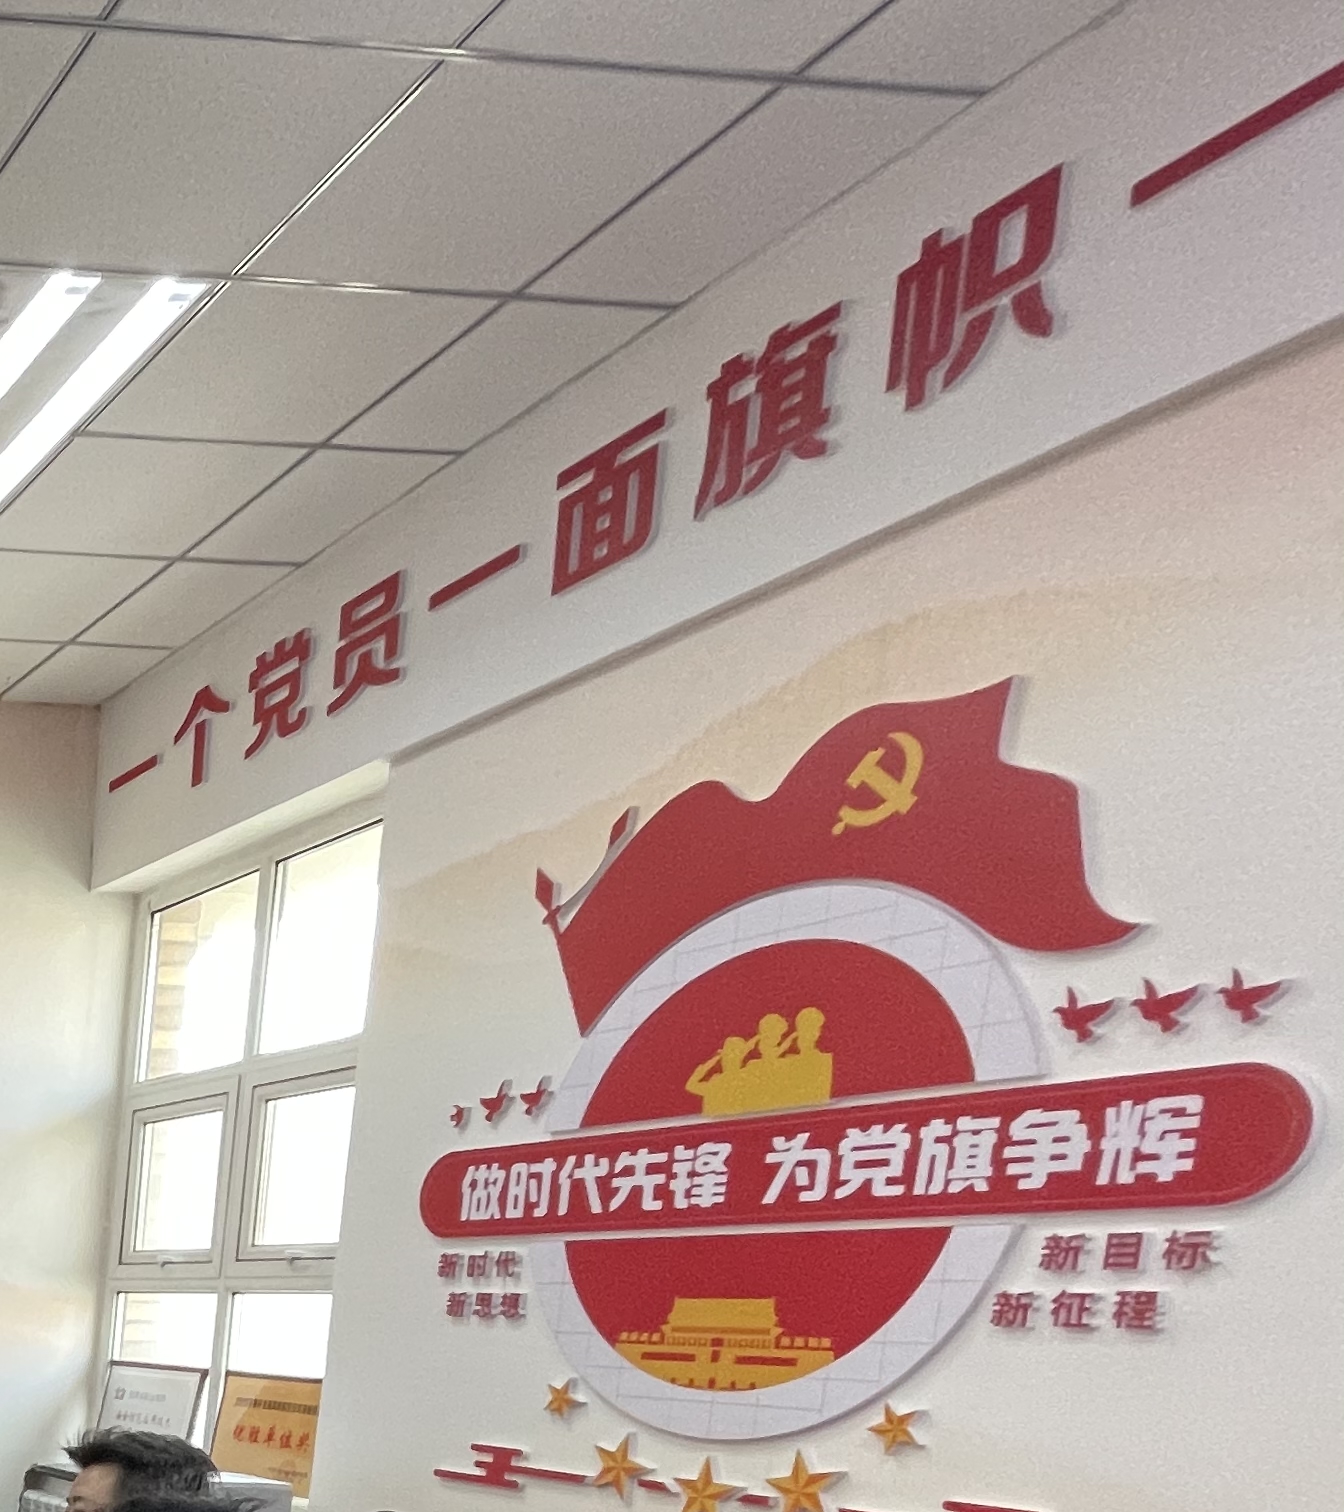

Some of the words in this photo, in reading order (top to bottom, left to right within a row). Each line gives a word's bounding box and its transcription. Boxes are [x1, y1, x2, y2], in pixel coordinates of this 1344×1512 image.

[460, 1142, 732, 1222] 做时代先锋
[761, 1094, 1204, 1206] 为党旗争辉
[437, 1250, 517, 1278] 新时代
[1038, 1229, 1213, 1271] 新目标
[990, 1289, 1159, 1331] 新征程
